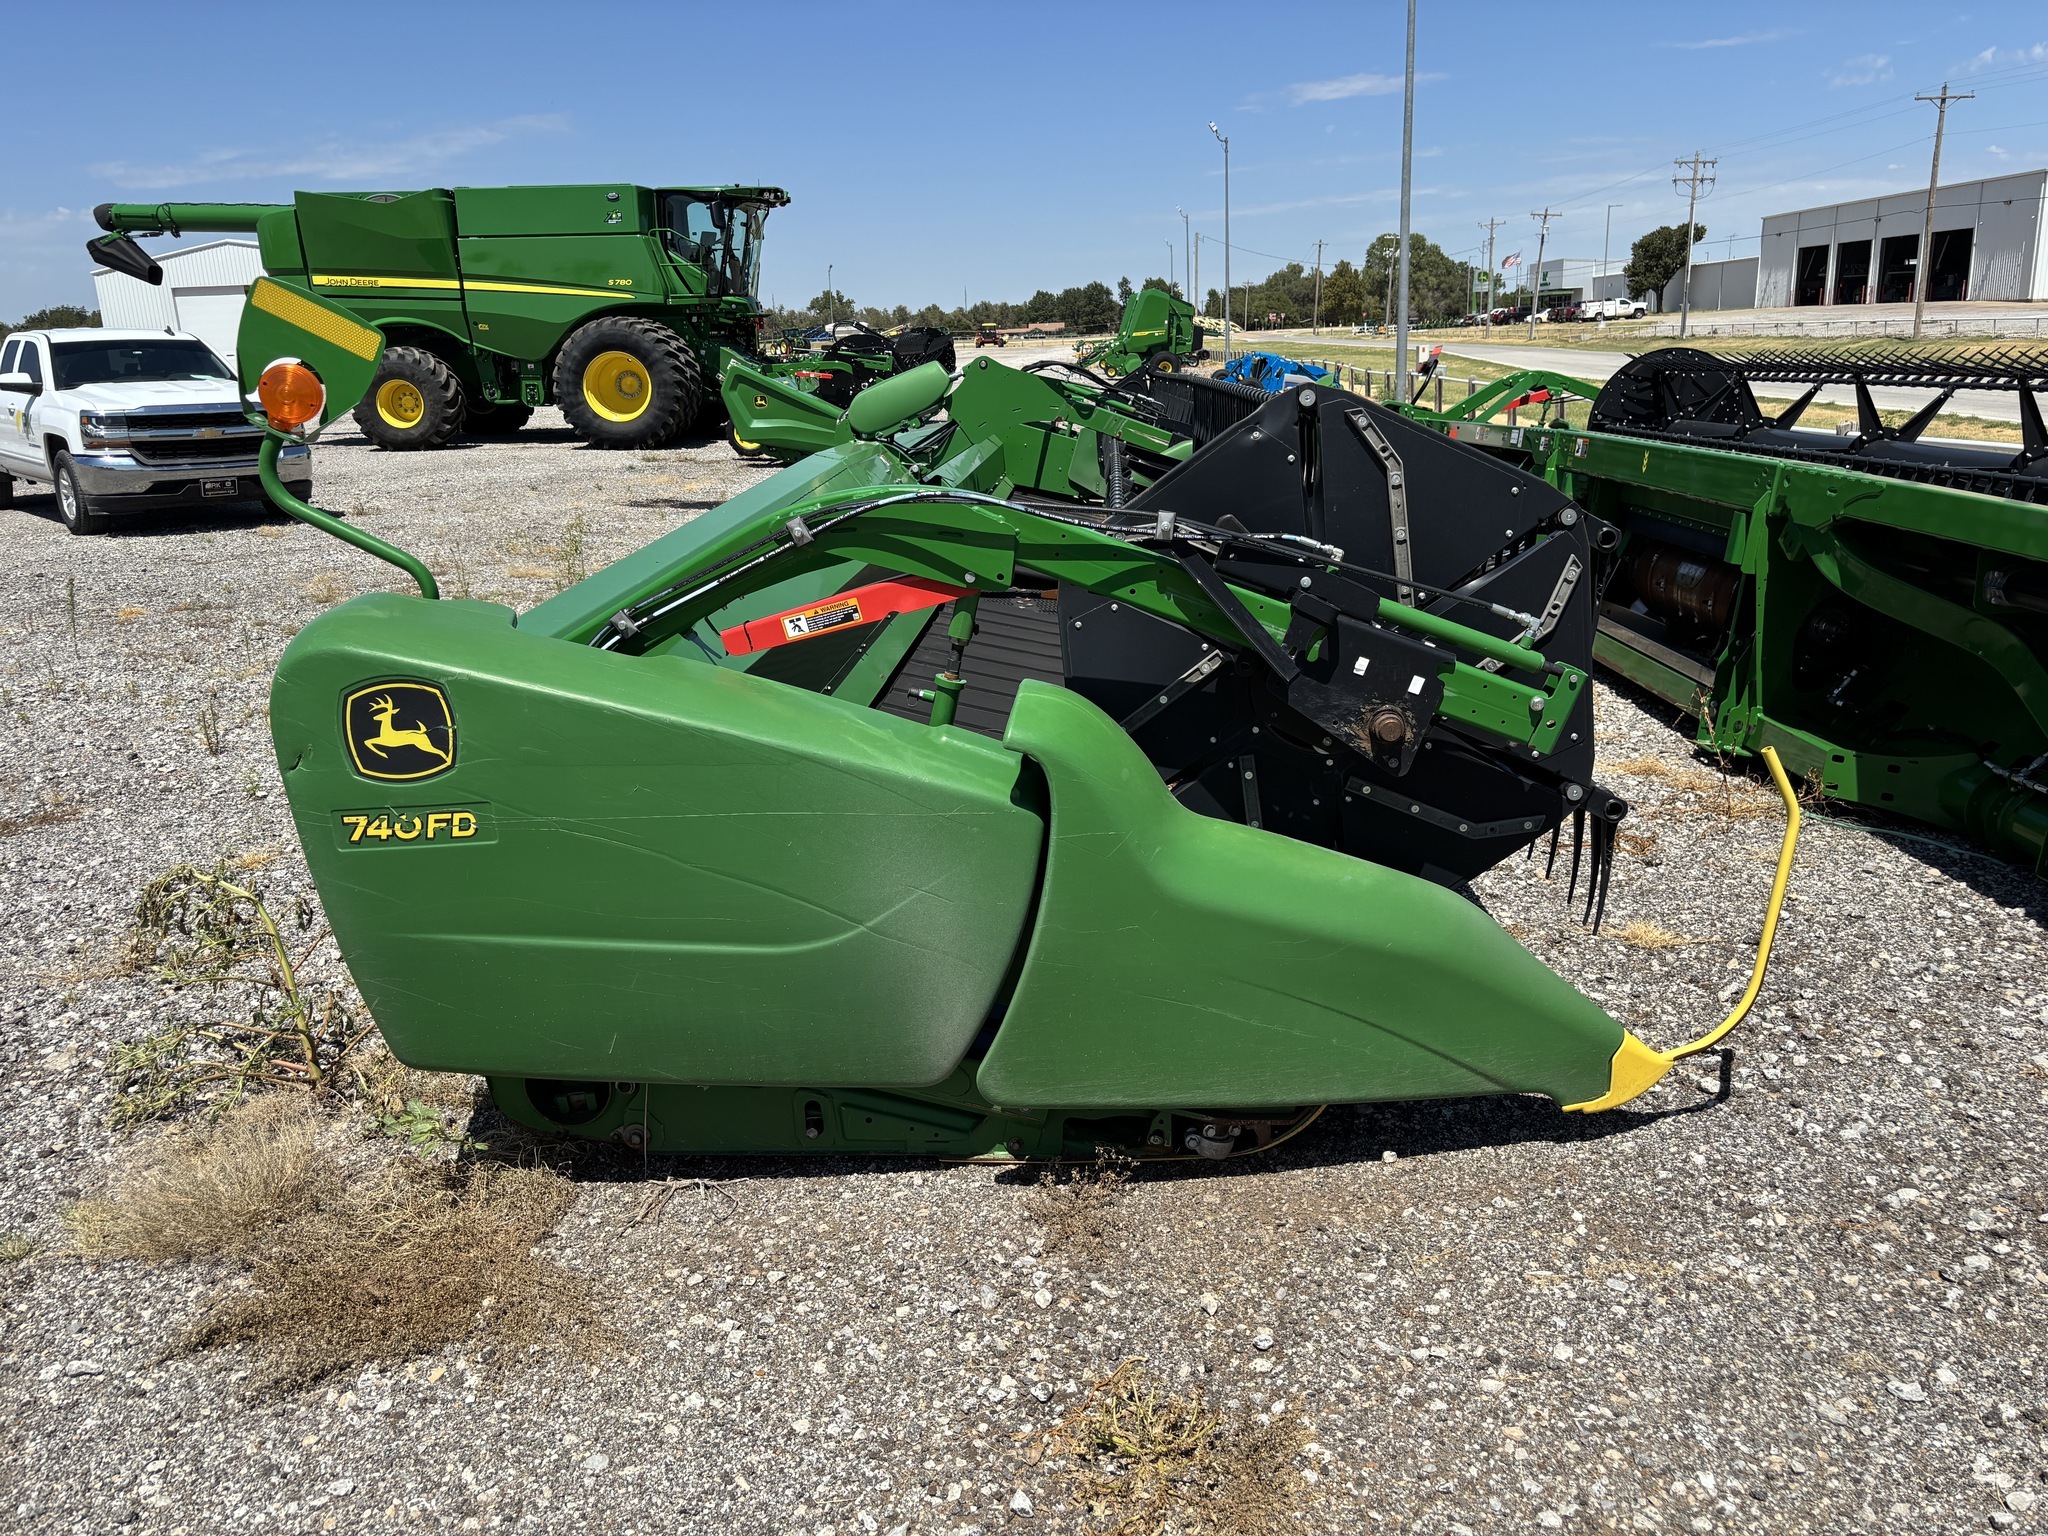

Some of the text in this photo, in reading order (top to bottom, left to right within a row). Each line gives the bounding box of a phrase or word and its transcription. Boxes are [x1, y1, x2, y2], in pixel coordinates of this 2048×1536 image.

[325, 277, 379, 286] JOHN DEERE
[820, 600, 850, 613] WARNING
[342, 811, 478, 844] 740FD
